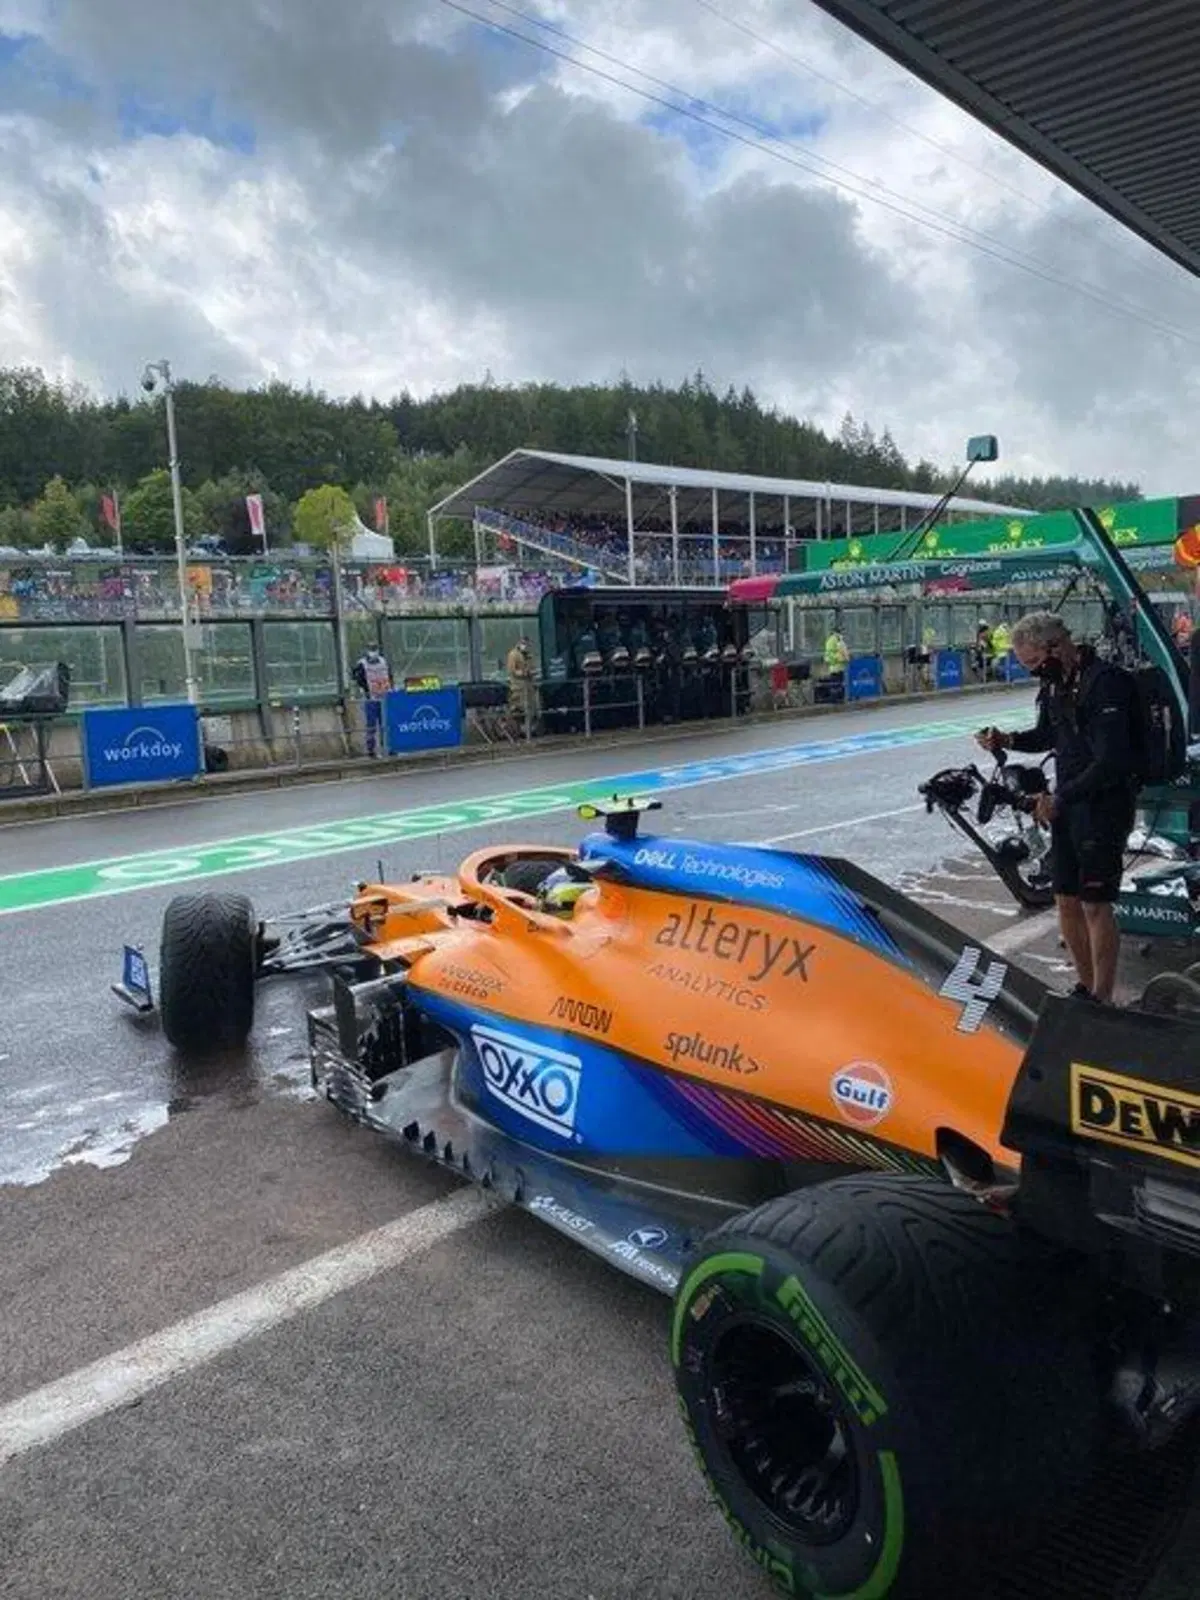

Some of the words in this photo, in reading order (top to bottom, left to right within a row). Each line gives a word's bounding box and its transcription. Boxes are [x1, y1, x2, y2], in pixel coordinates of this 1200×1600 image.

[820, 570, 865, 589] ASTON
[869, 562, 926, 584] MARTIN
[397, 717, 452, 733] workday
[103, 741, 183, 762] workday
[634, 848, 676, 870] DELL
[680, 853, 785, 888] Technologies
[1132, 905, 1189, 924] MARTIN
[655, 903, 816, 983] alteryx
[649, 962, 767, 1011] ANALYTICS
[938, 944, 1008, 1033] 4
[481, 1042, 574, 1116] OXXO
[835, 1078, 888, 1109] Gulf
